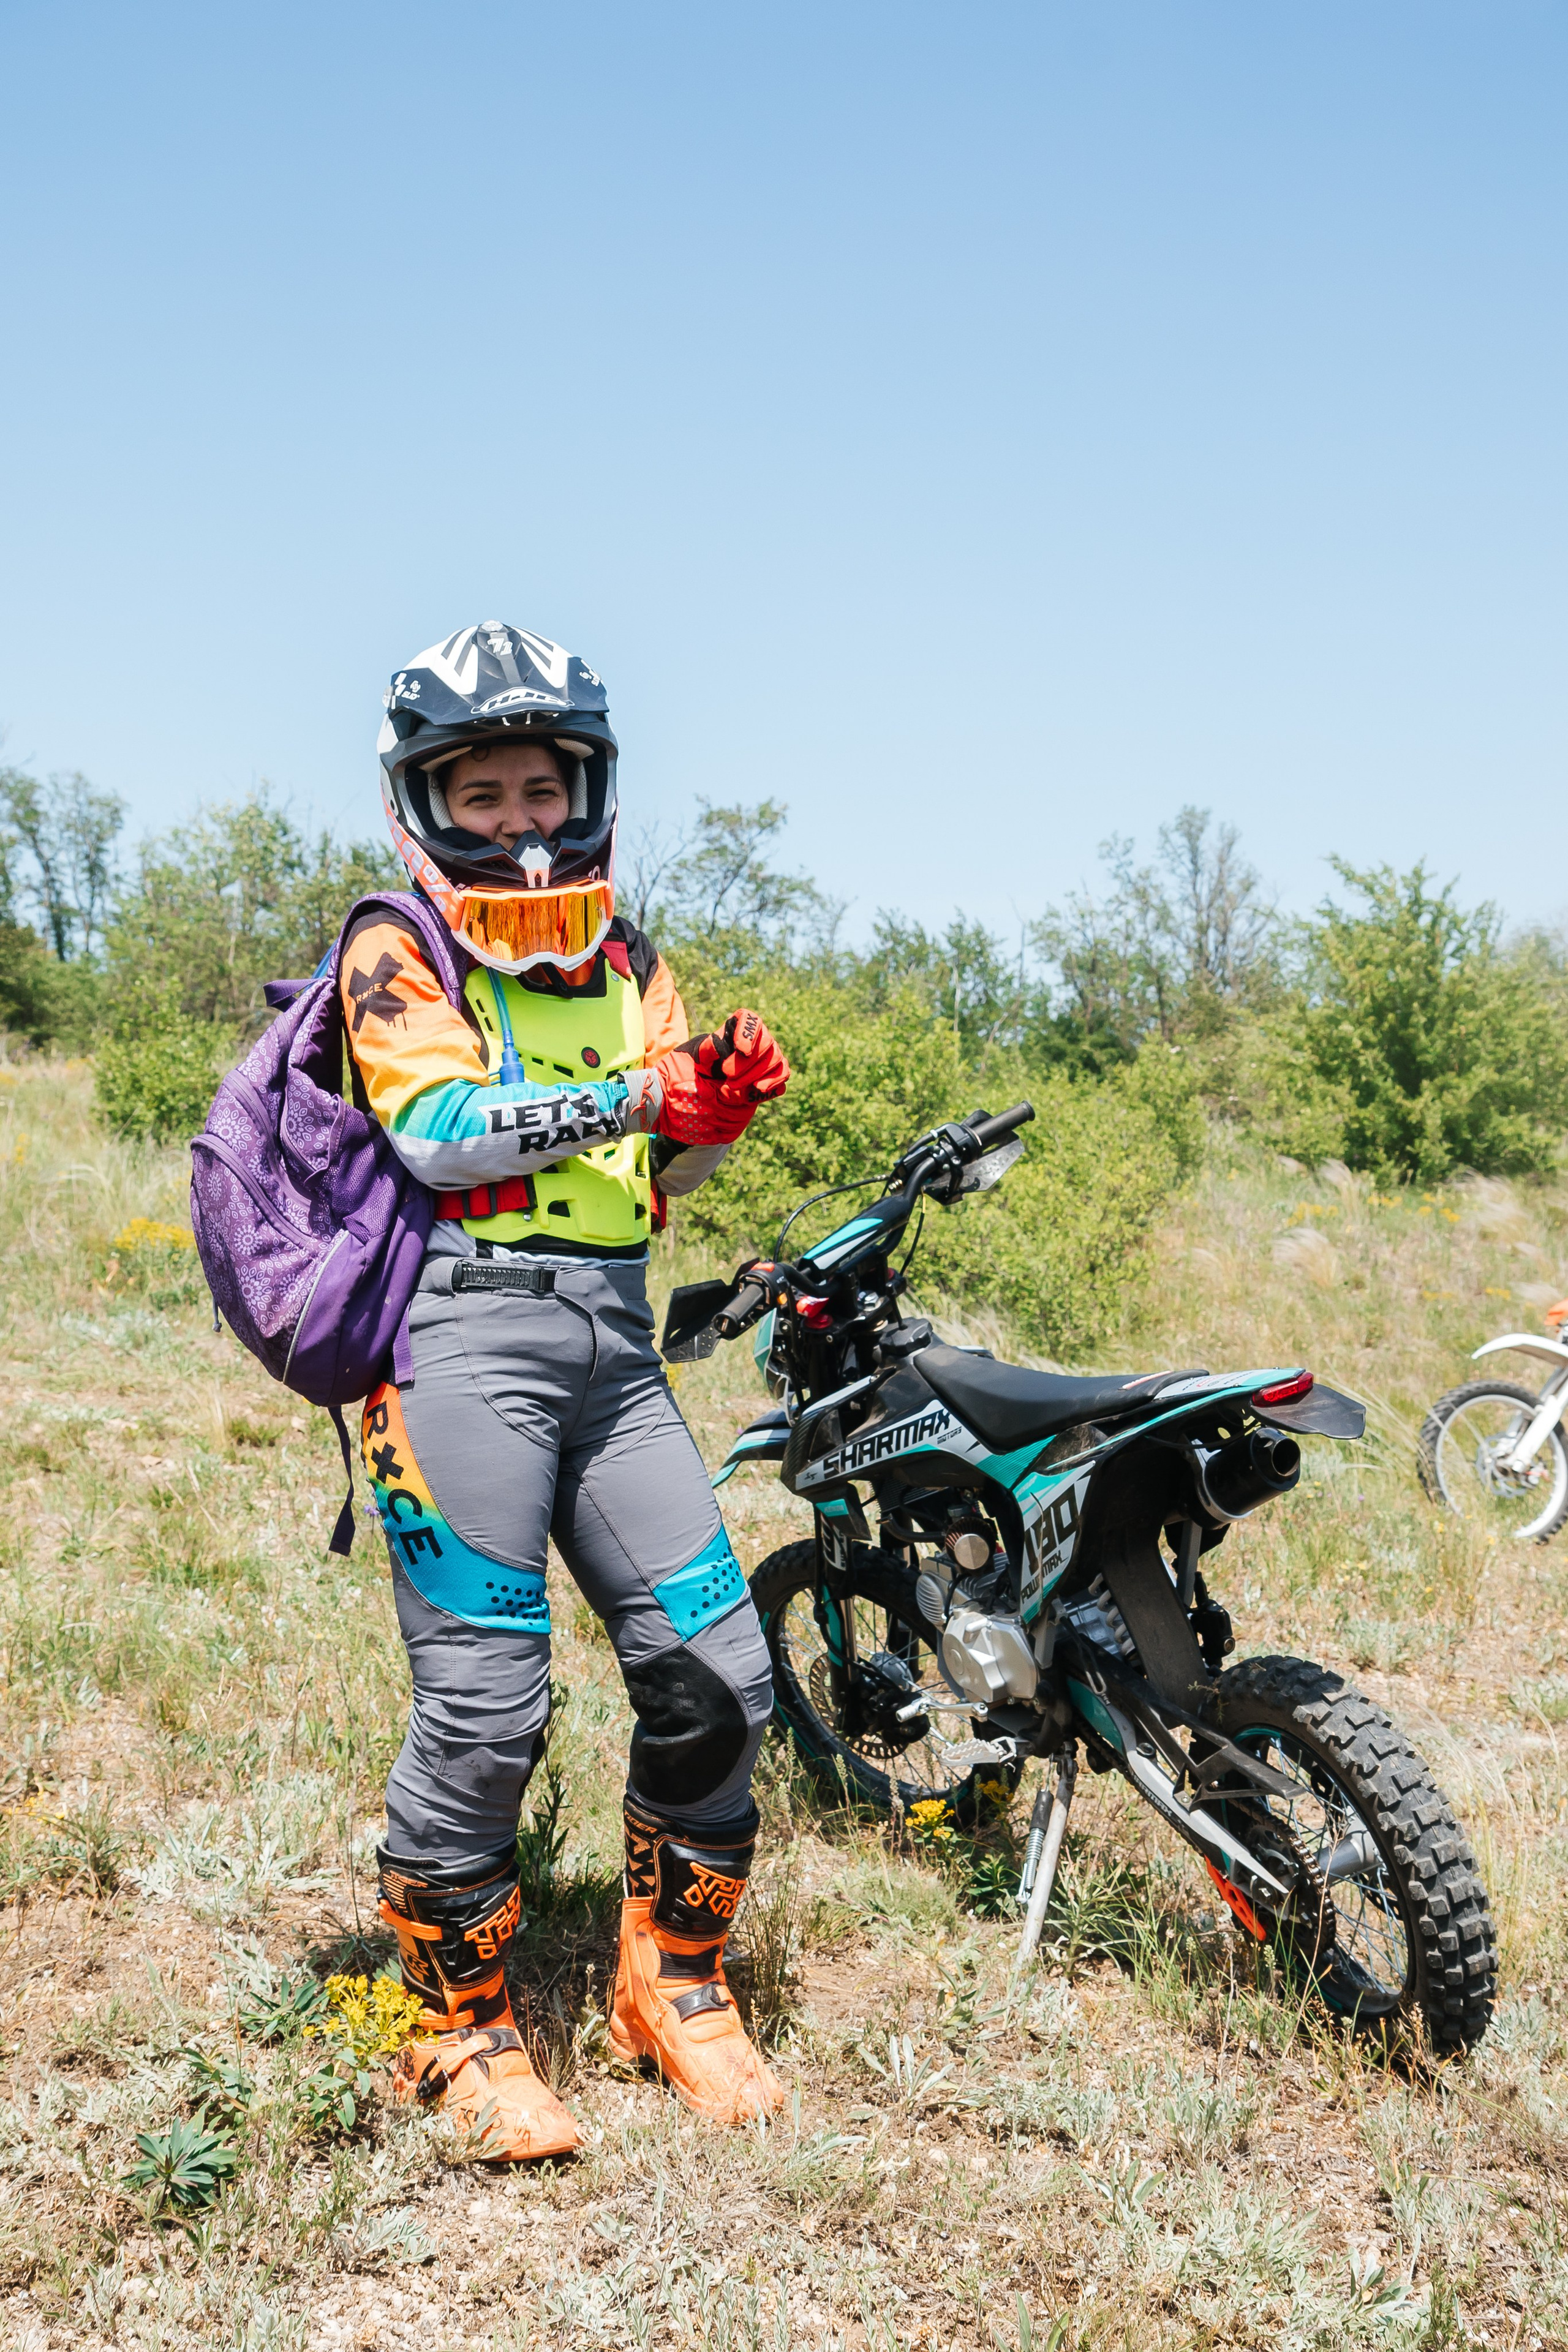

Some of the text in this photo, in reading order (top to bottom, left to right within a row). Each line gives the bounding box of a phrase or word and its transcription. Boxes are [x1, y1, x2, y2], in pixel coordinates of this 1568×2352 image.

[742, 1014, 758, 1041] SMX
[823, 1408, 951, 1481] SHARMAX
[625, 1809, 658, 1834] TIGER
